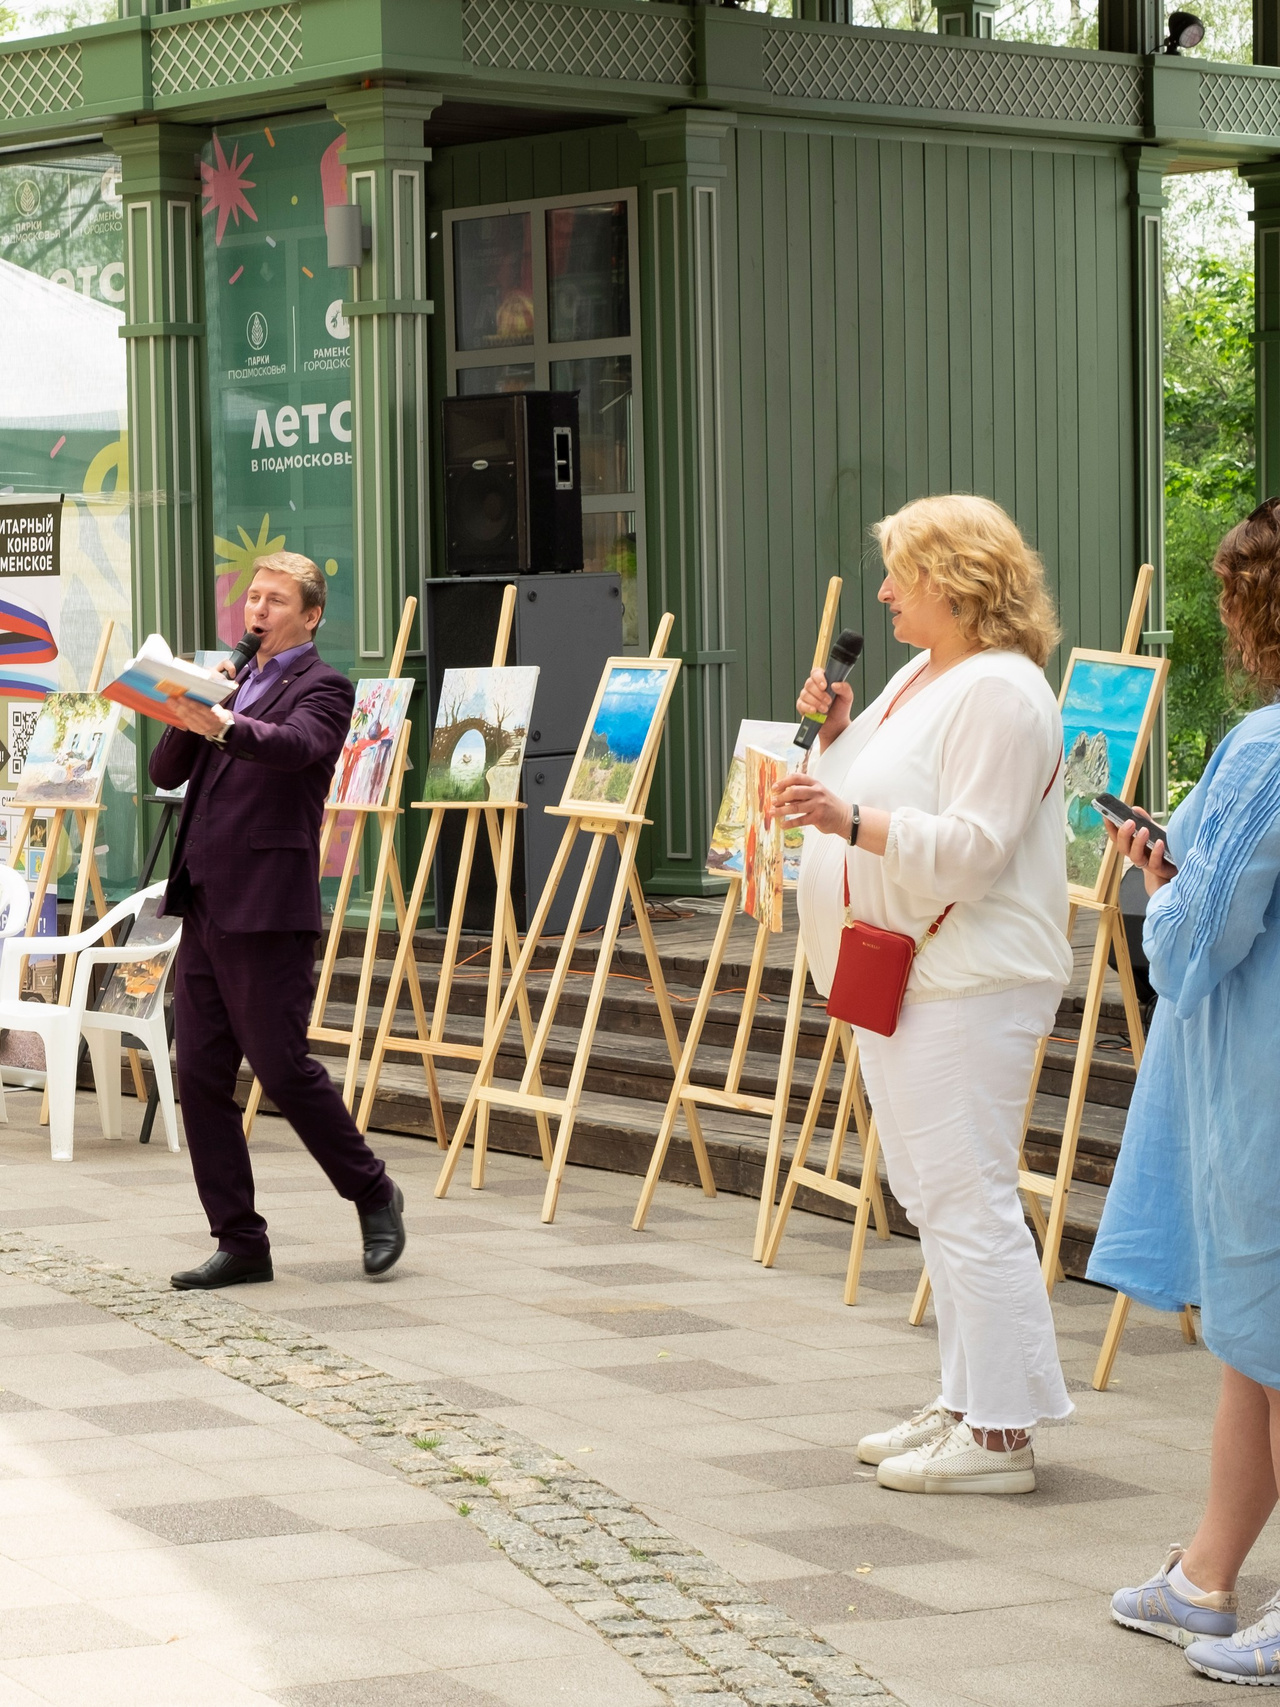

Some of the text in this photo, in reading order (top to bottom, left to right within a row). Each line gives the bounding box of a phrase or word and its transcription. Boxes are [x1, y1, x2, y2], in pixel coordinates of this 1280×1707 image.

[15, 220, 42, 234] ПАРКИ
[247, 354, 270, 367] ПАРКИ
[228, 363, 287, 380] ПОДМОСКОВЬЯ
[7, 532, 53, 553] КОНВОЙ
